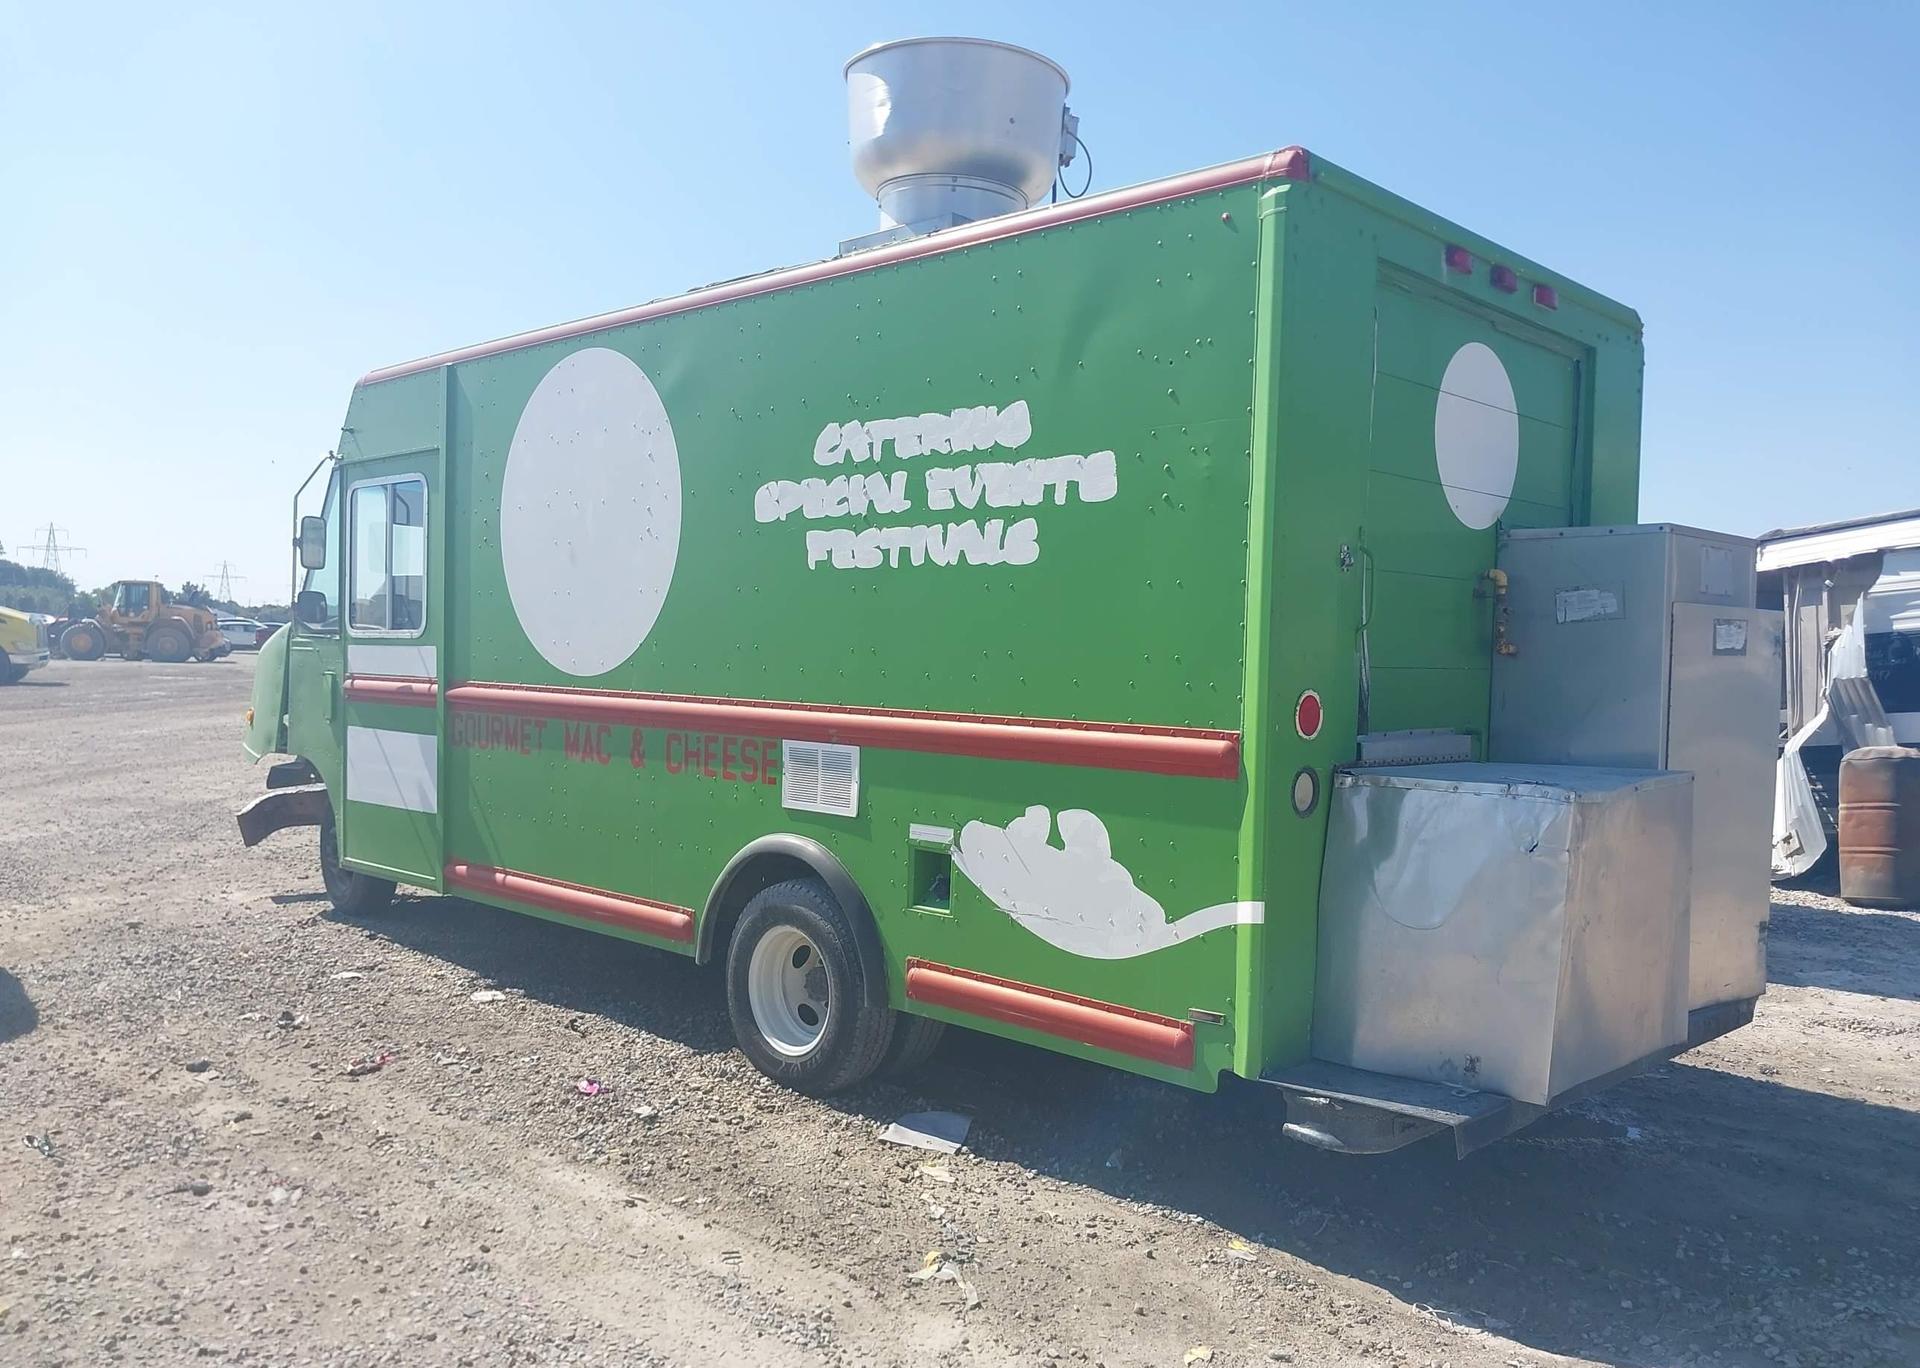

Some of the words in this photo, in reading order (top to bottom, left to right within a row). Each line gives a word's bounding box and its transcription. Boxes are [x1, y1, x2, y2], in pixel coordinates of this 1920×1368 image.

[813, 400, 1032, 465] CATERING
[755, 471, 911, 523] SPECIAL
[926, 450, 1118, 510] EVENTS
[806, 518, 1040, 570] FESTIVALS
[451, 713, 546, 755] GOURMET
[564, 721, 612, 765] MAC
[631, 728, 646, 768] &
[666, 733, 777, 785] CHEESE
